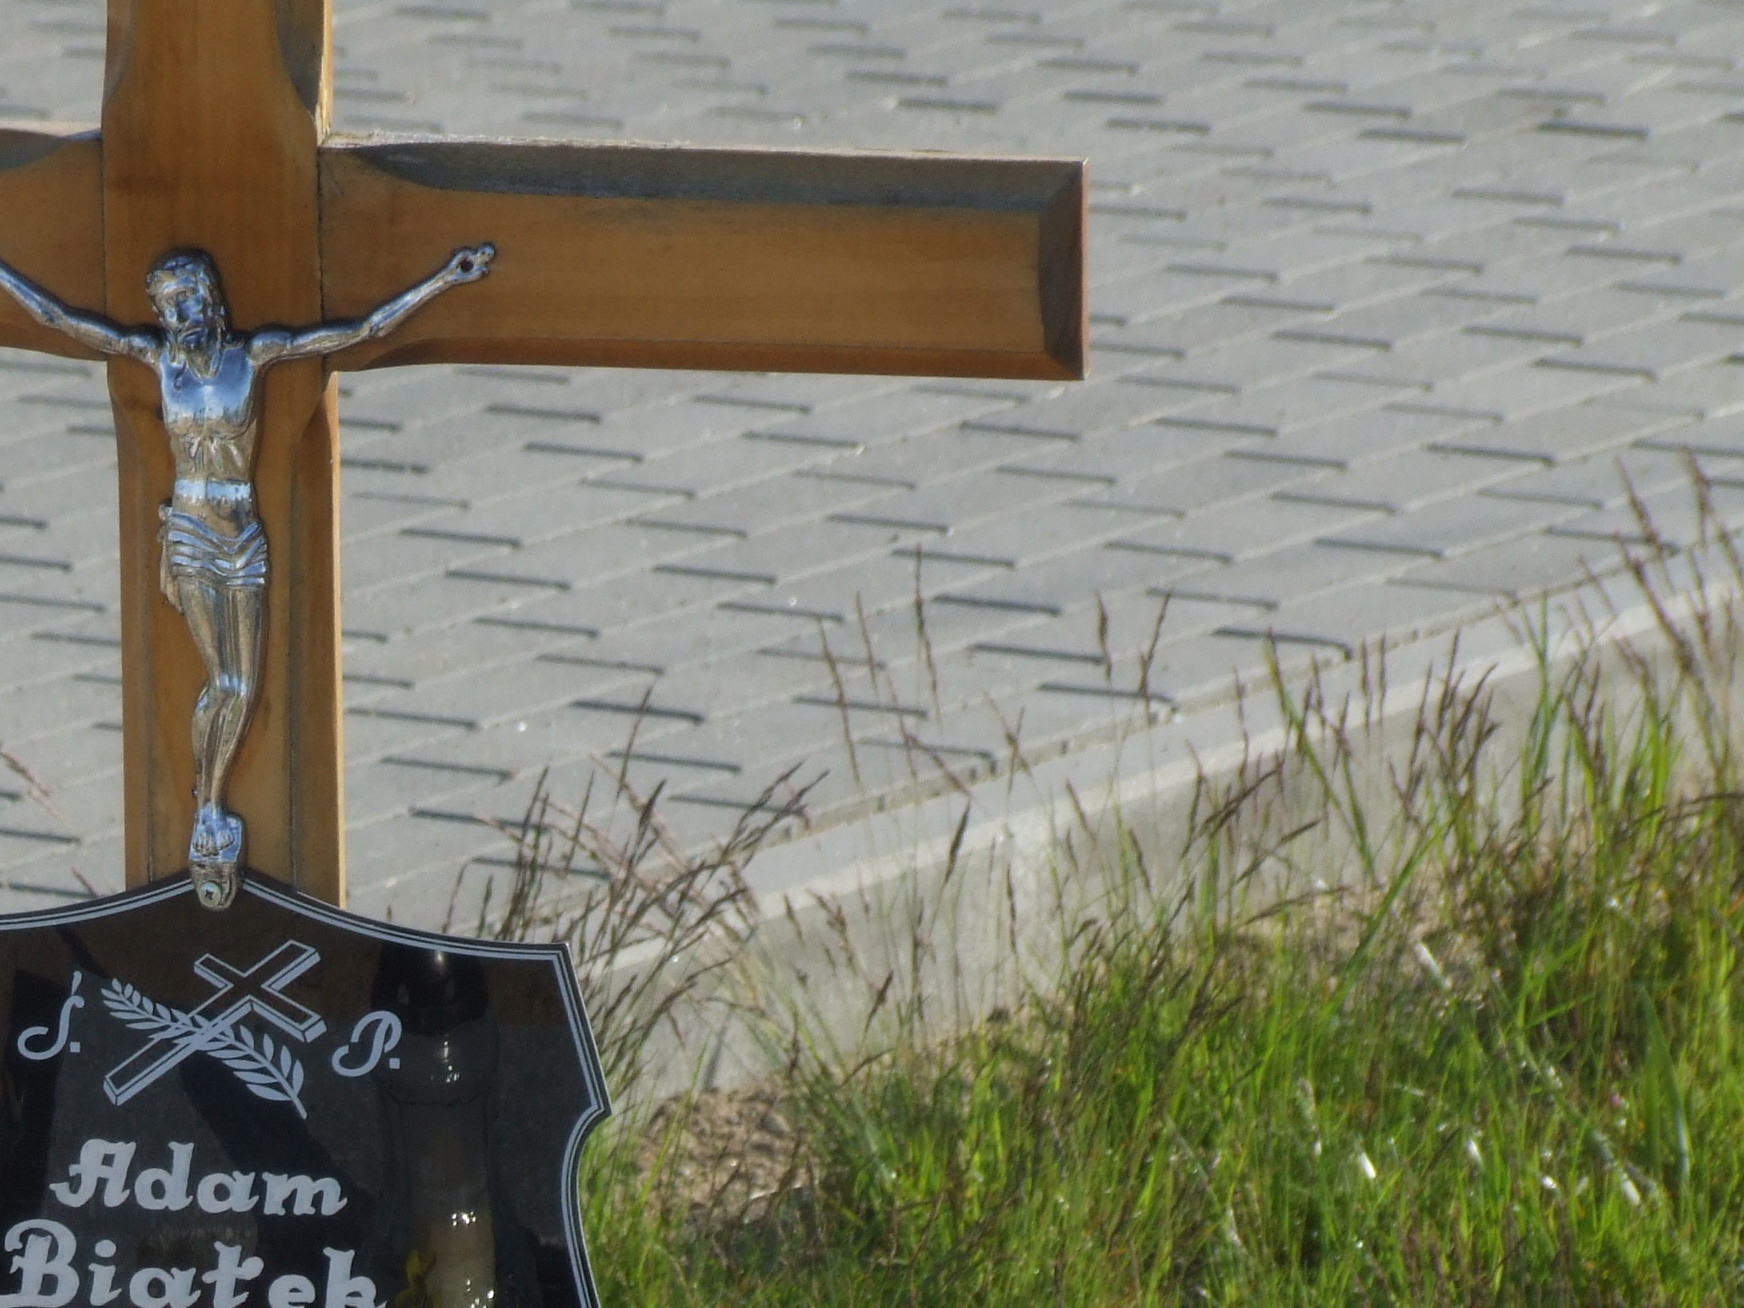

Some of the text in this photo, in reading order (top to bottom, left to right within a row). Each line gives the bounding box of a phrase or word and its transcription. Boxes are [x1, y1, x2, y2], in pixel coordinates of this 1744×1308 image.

[17, 971, 404, 1076] Ś. P.
[50, 1138, 348, 1216] Adam
